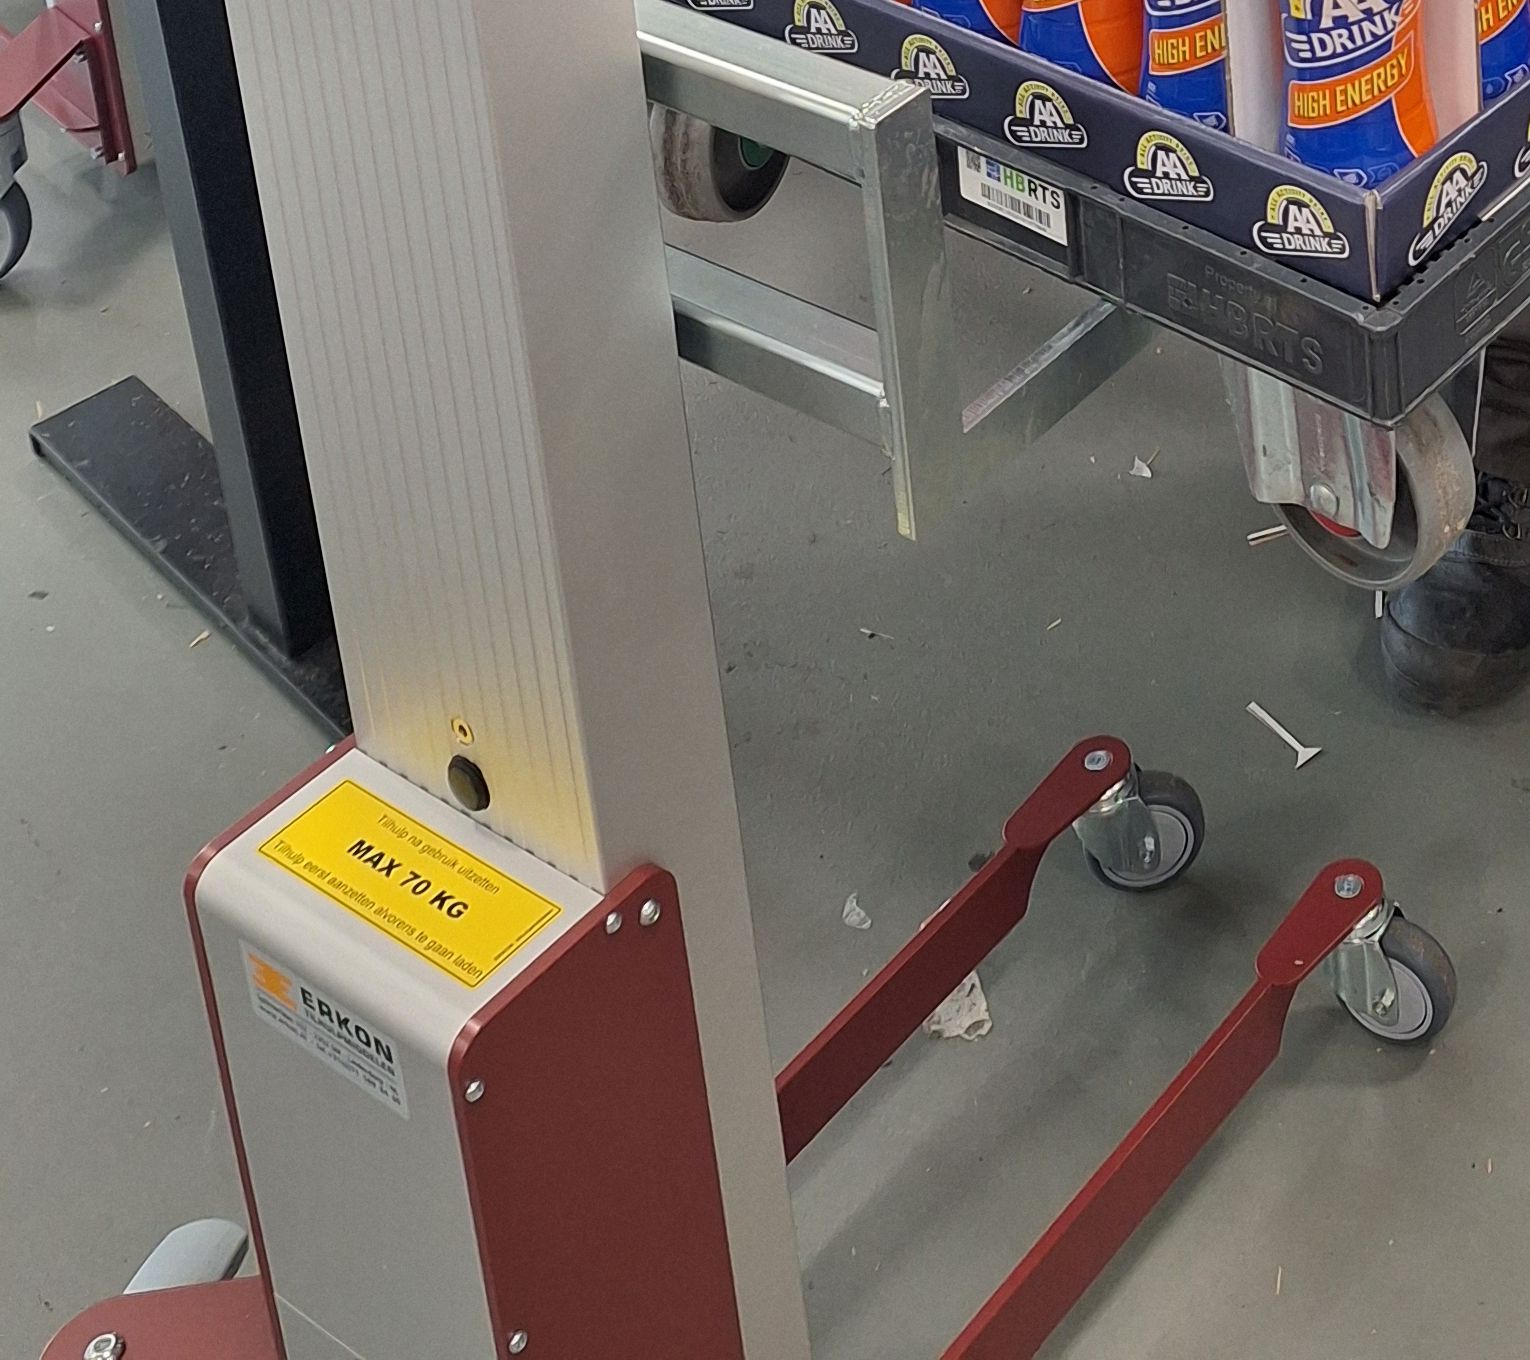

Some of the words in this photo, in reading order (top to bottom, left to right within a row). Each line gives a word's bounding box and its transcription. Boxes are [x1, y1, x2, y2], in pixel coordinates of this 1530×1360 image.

[810, 9, 837, 34] AA
[1310, 2, 1402, 58] DRINK
[807, 35, 844, 48] DRINK
[1155, 38, 1190, 65] HIGH
[918, 53, 947, 79] AA
[1295, 91, 1331, 118] HIGH
[1336, 50, 1408, 113] ENERGY
[1034, 100, 1064, 128] AA
[1030, 127, 1072, 143] DRINK
[1155, 150, 1188, 179] AA
[1003, 166, 1061, 210] HBRTS
[1152, 177, 1197, 196] DRINK
[1439, 169, 1468, 215] AA
[1287, 205, 1323, 236] AA
[1434, 182, 1477, 237] DRINK
[1281, 232, 1332, 252] DRINK
[347, 839, 401, 879] MAX
[400, 871, 432, 896] 70
[429, 890, 469, 920] KG
[407, 833, 421, 847] na
[421, 841, 459, 871] gebruik
[458, 864, 501, 895] uitzetten
[273, 839, 305, 866] Tilhulp
[303, 857, 330, 881] eerst
[327, 874, 376, 911] aanzetten
[373, 905, 416, 937] alvorens
[415, 931, 426, 944] te
[424, 939, 454, 962] gaan
[452, 955, 484, 979] laden
[300, 986, 394, 1064] ERKON
